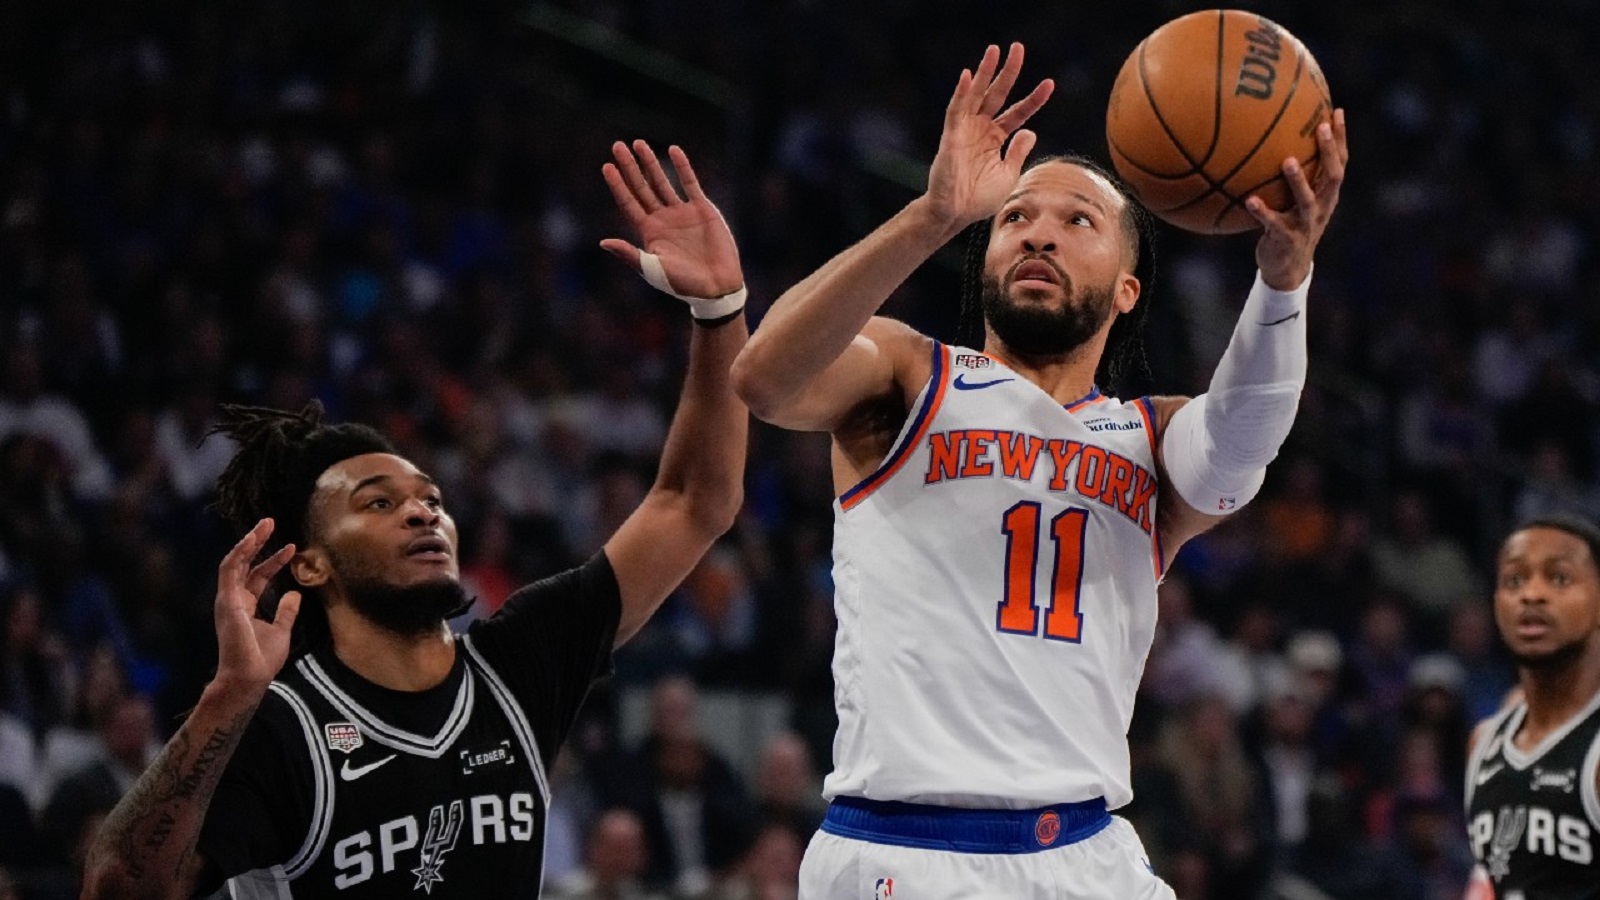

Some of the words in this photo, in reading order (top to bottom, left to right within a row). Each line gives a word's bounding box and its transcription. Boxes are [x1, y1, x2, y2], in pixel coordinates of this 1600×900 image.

[1105, 419, 1143, 431] dhabi
[925, 430, 1044, 486] NEW
[1048, 439, 1156, 534] YORK
[996, 500, 1089, 644] 11
[469, 749, 505, 766] LEDGER
[334, 793, 533, 894] SPURS
